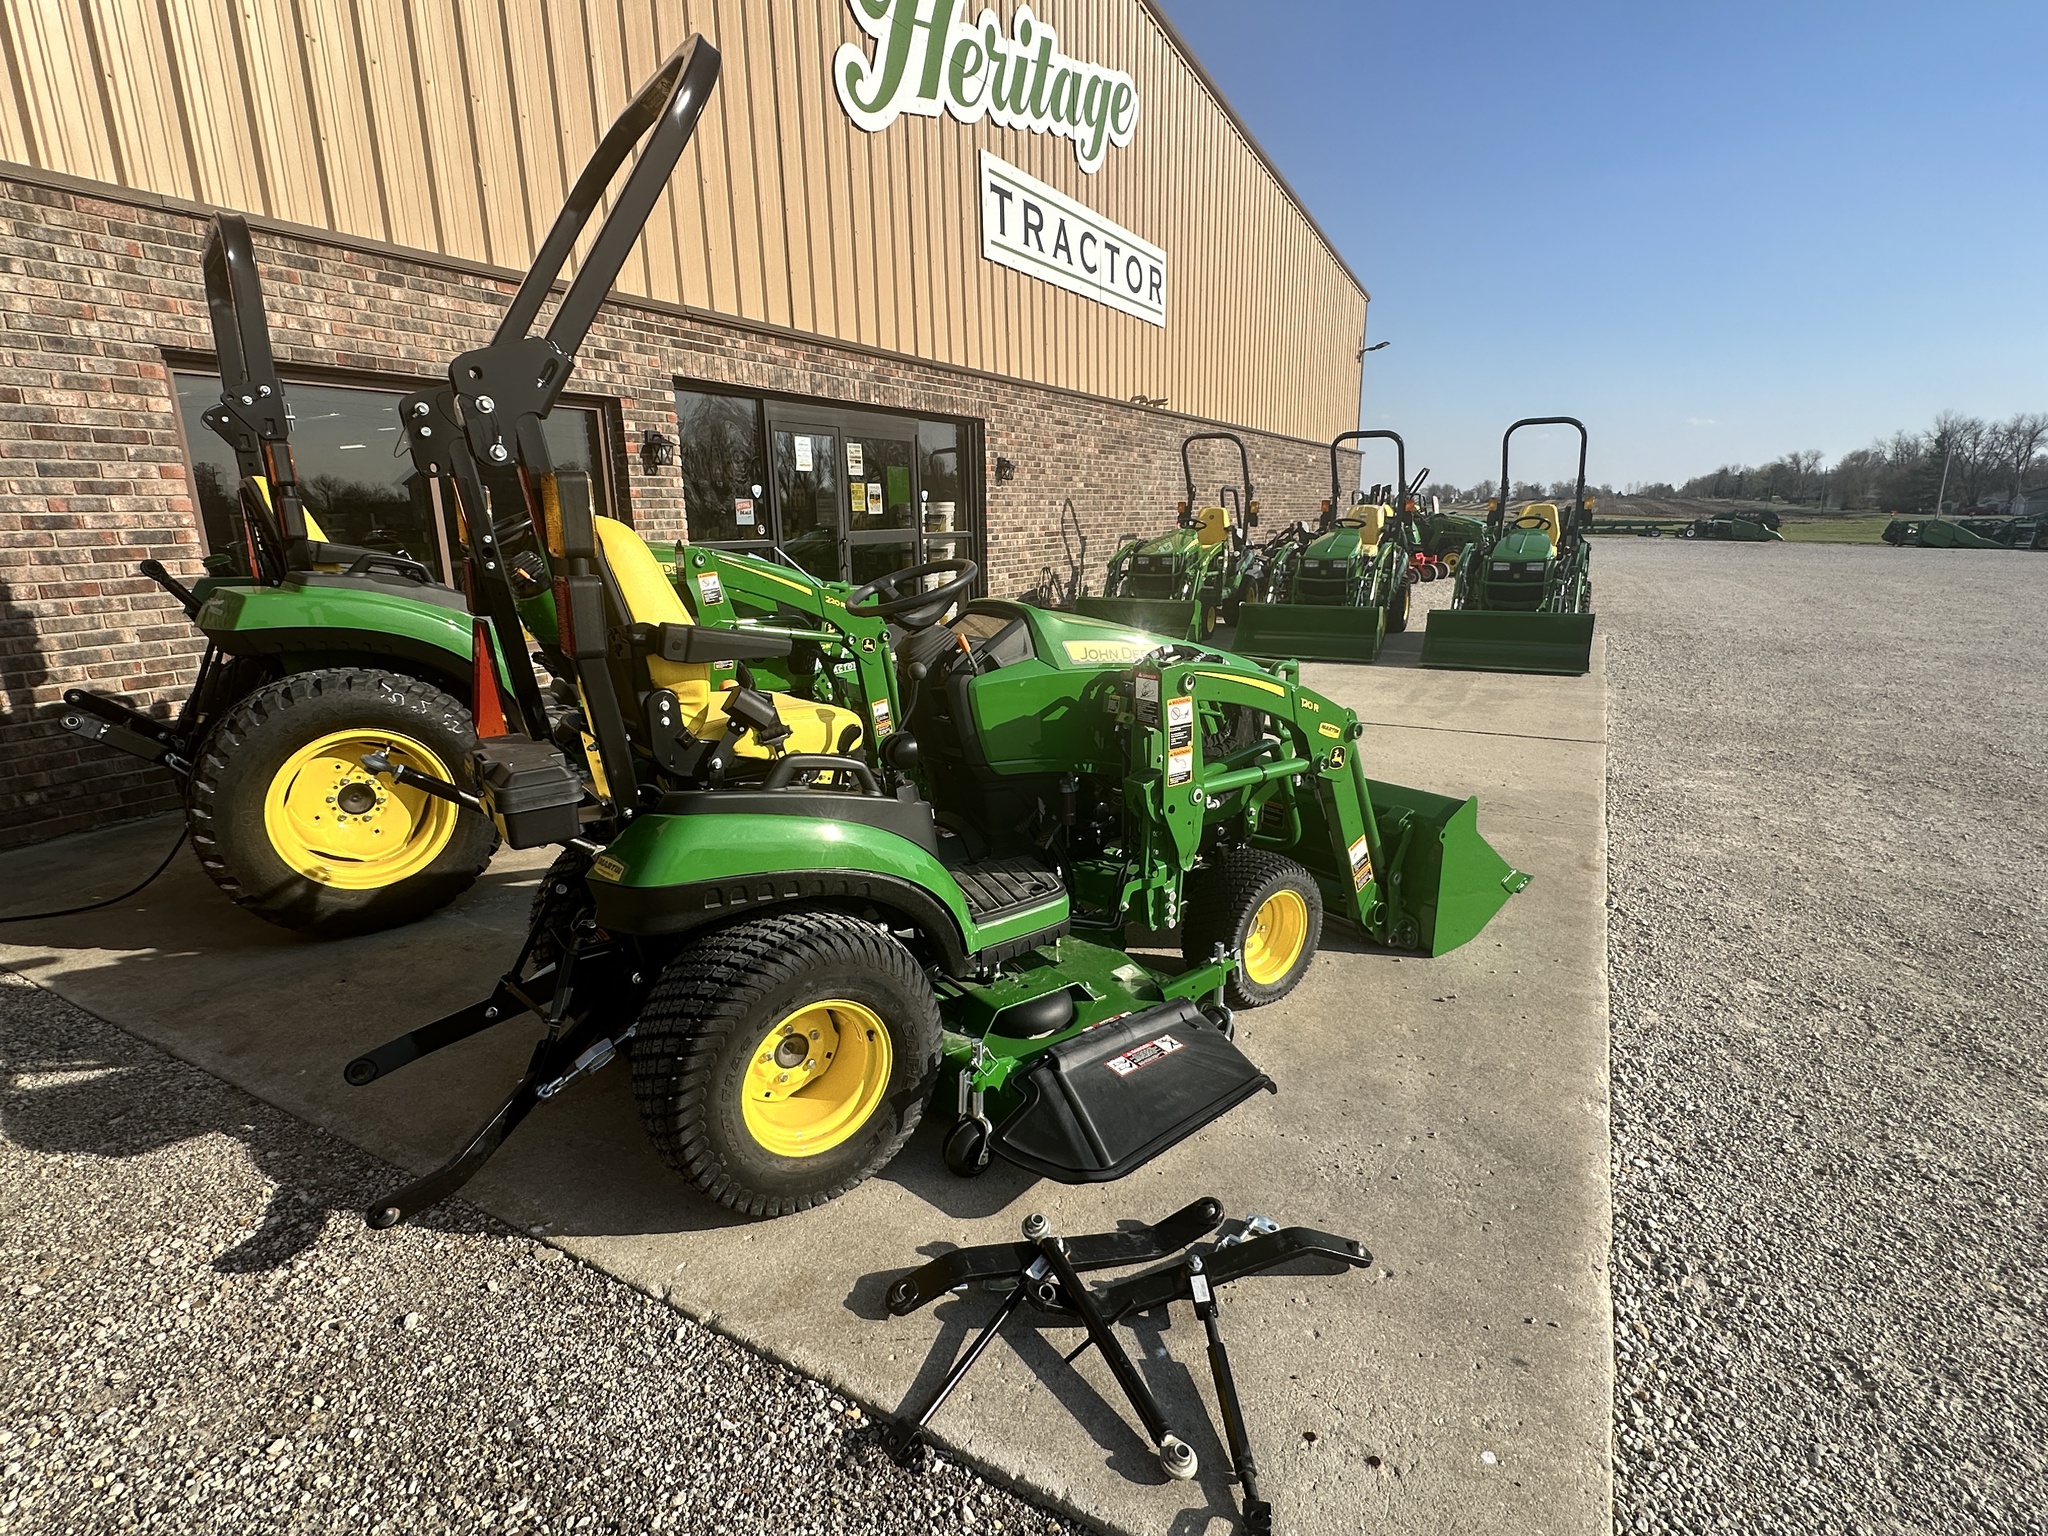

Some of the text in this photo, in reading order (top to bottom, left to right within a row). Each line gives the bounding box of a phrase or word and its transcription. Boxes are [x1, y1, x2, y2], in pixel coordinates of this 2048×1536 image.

[846, 0, 1135, 161] Heritage
[990, 181, 1162, 305] TRACTOR
[825, 596, 840, 607] 220
[1080, 647, 1118, 660] JOHN
